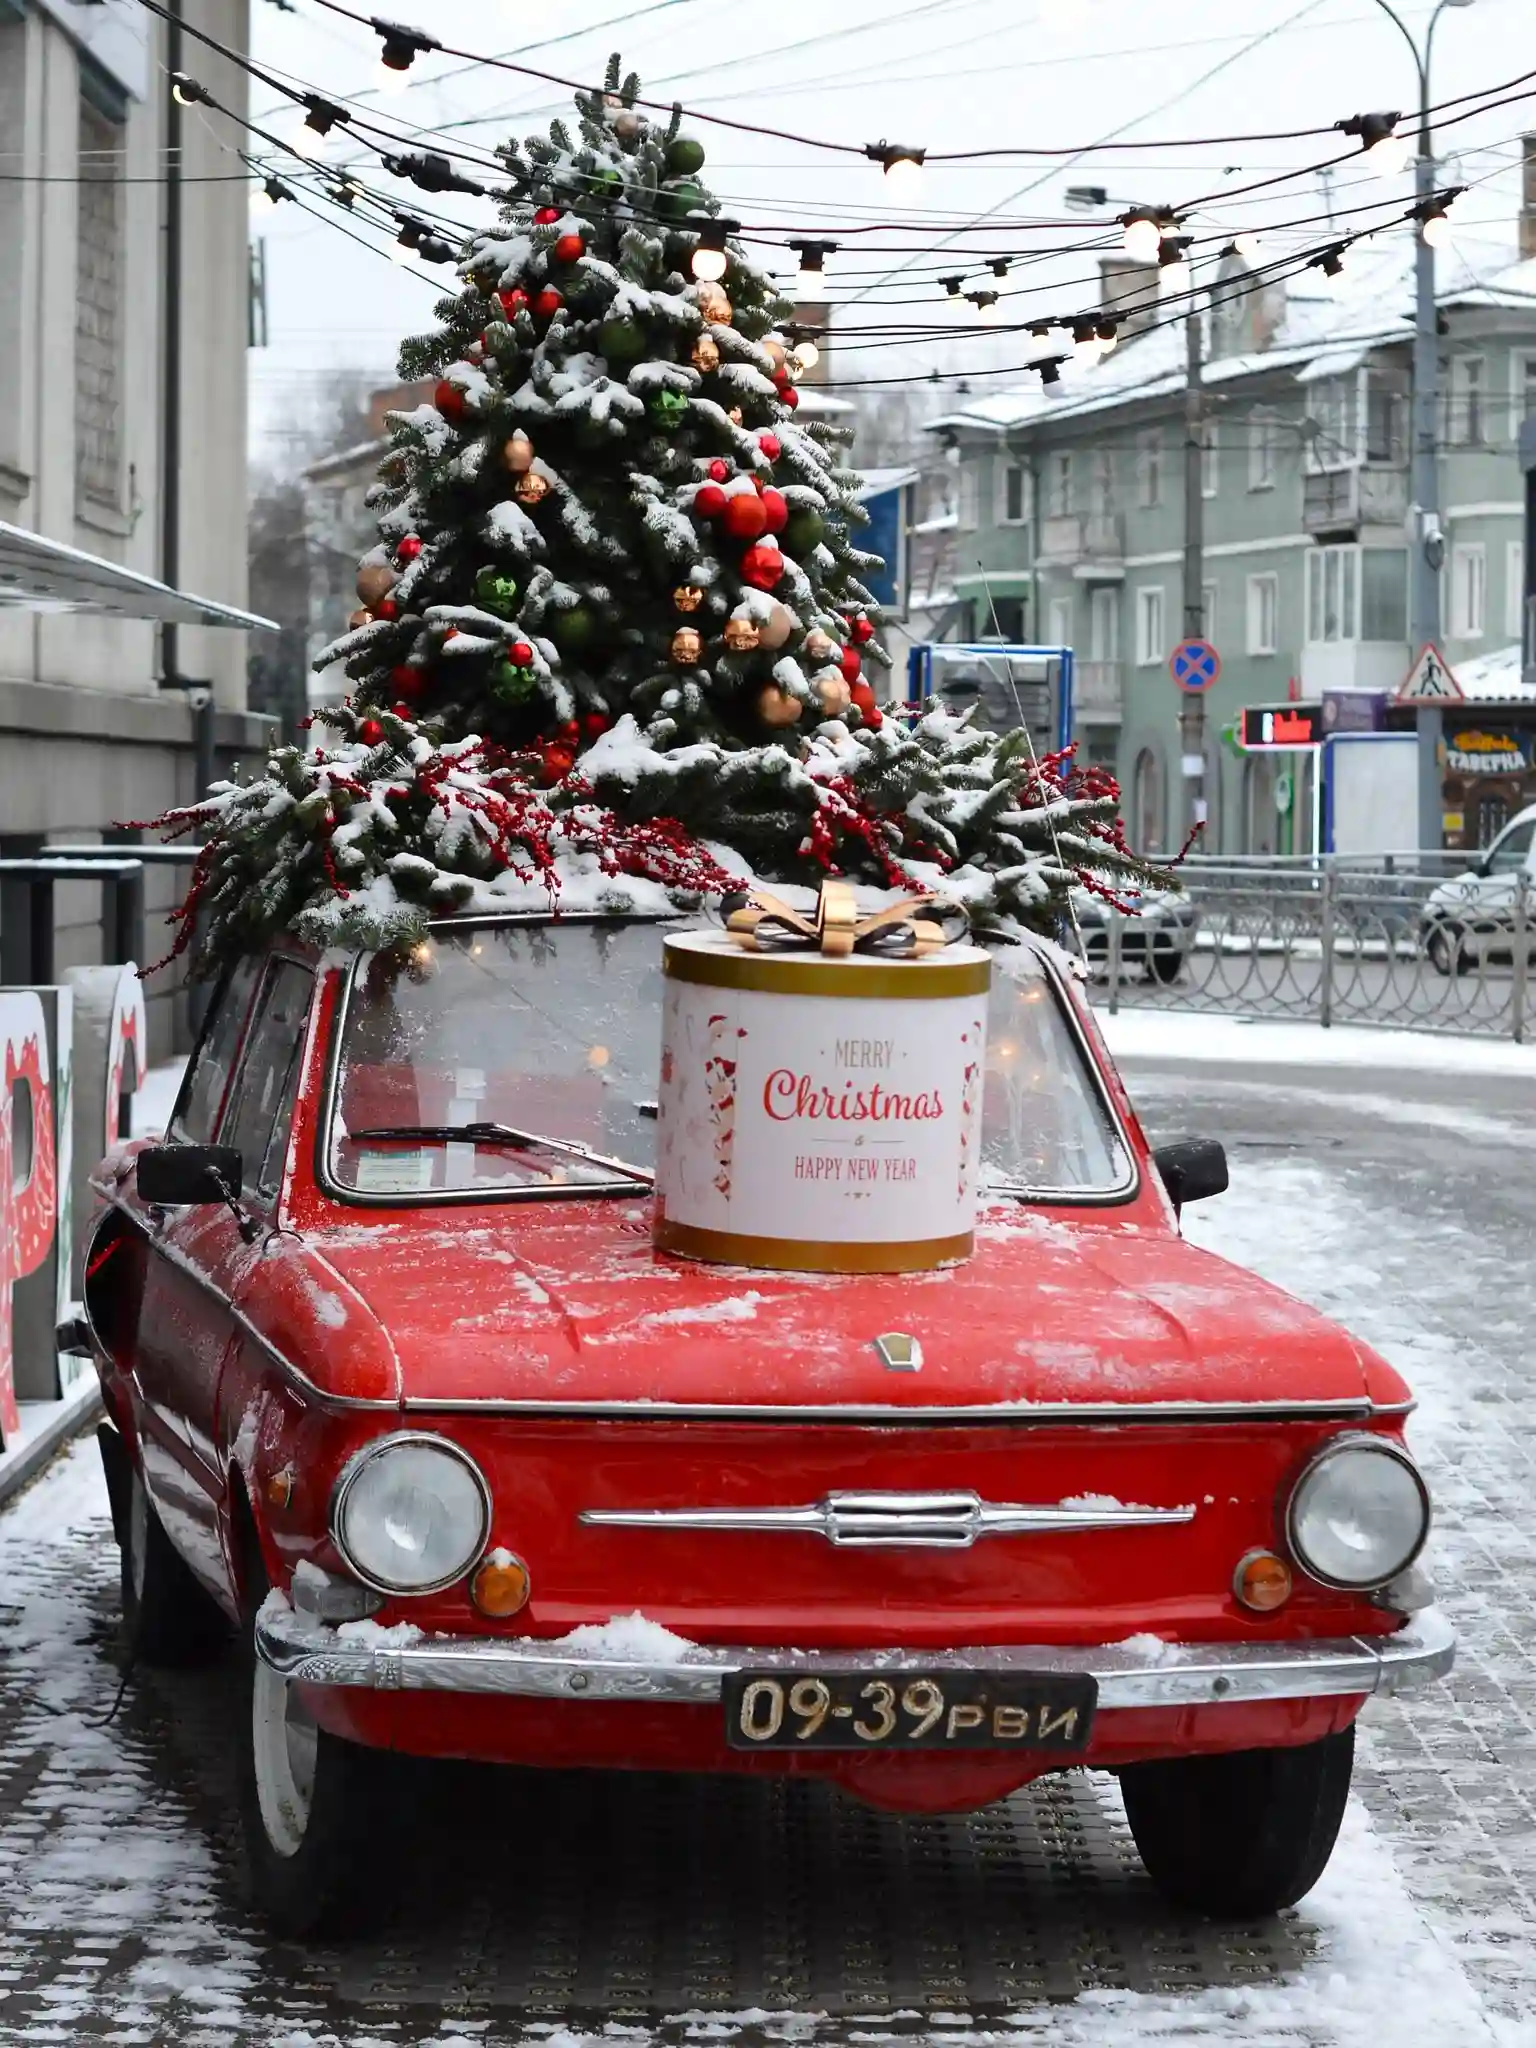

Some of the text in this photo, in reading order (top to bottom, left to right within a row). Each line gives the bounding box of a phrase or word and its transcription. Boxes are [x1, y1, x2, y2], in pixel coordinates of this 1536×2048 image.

[834, 1037, 895, 1069] MERRY
[763, 1068, 944, 1121] Christmas
[794, 1155, 917, 1181] HAPPY NEW YEAR
